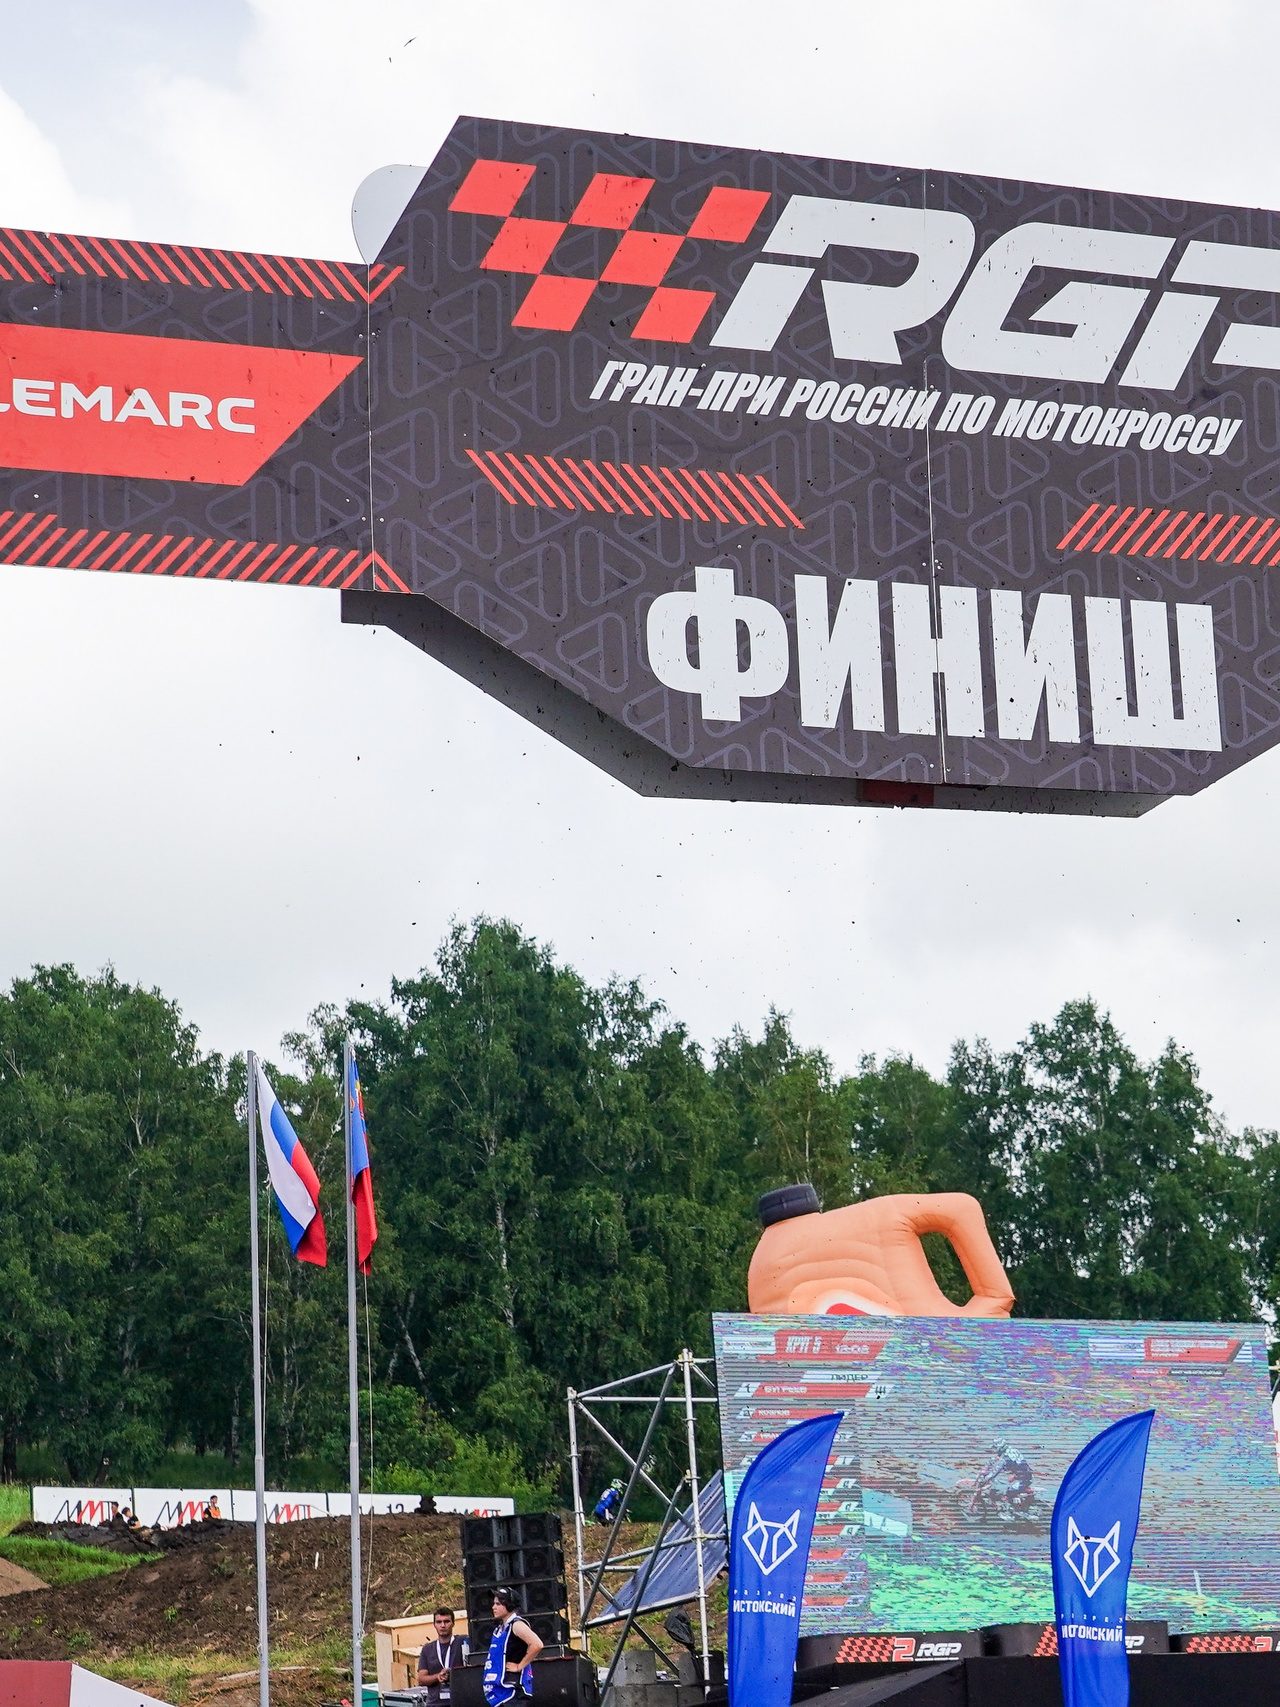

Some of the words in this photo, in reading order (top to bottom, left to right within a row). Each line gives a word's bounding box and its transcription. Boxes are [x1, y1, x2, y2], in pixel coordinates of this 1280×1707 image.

[0, 378, 256, 434] EMARC
[589, 360, 787, 416] ГРАН-ПРИ
[779, 378, 942, 430] РОССИИ
[935, 392, 996, 434] ПО
[992, 398, 1243, 456] МОТОКРОССУ
[647, 566, 1222, 752] ФИНИШ
[733, 1600, 796, 1617] ИСТОКСКИЙ
[892, 1637, 916, 1662] 2
[916, 1642, 962, 1657] RGP
